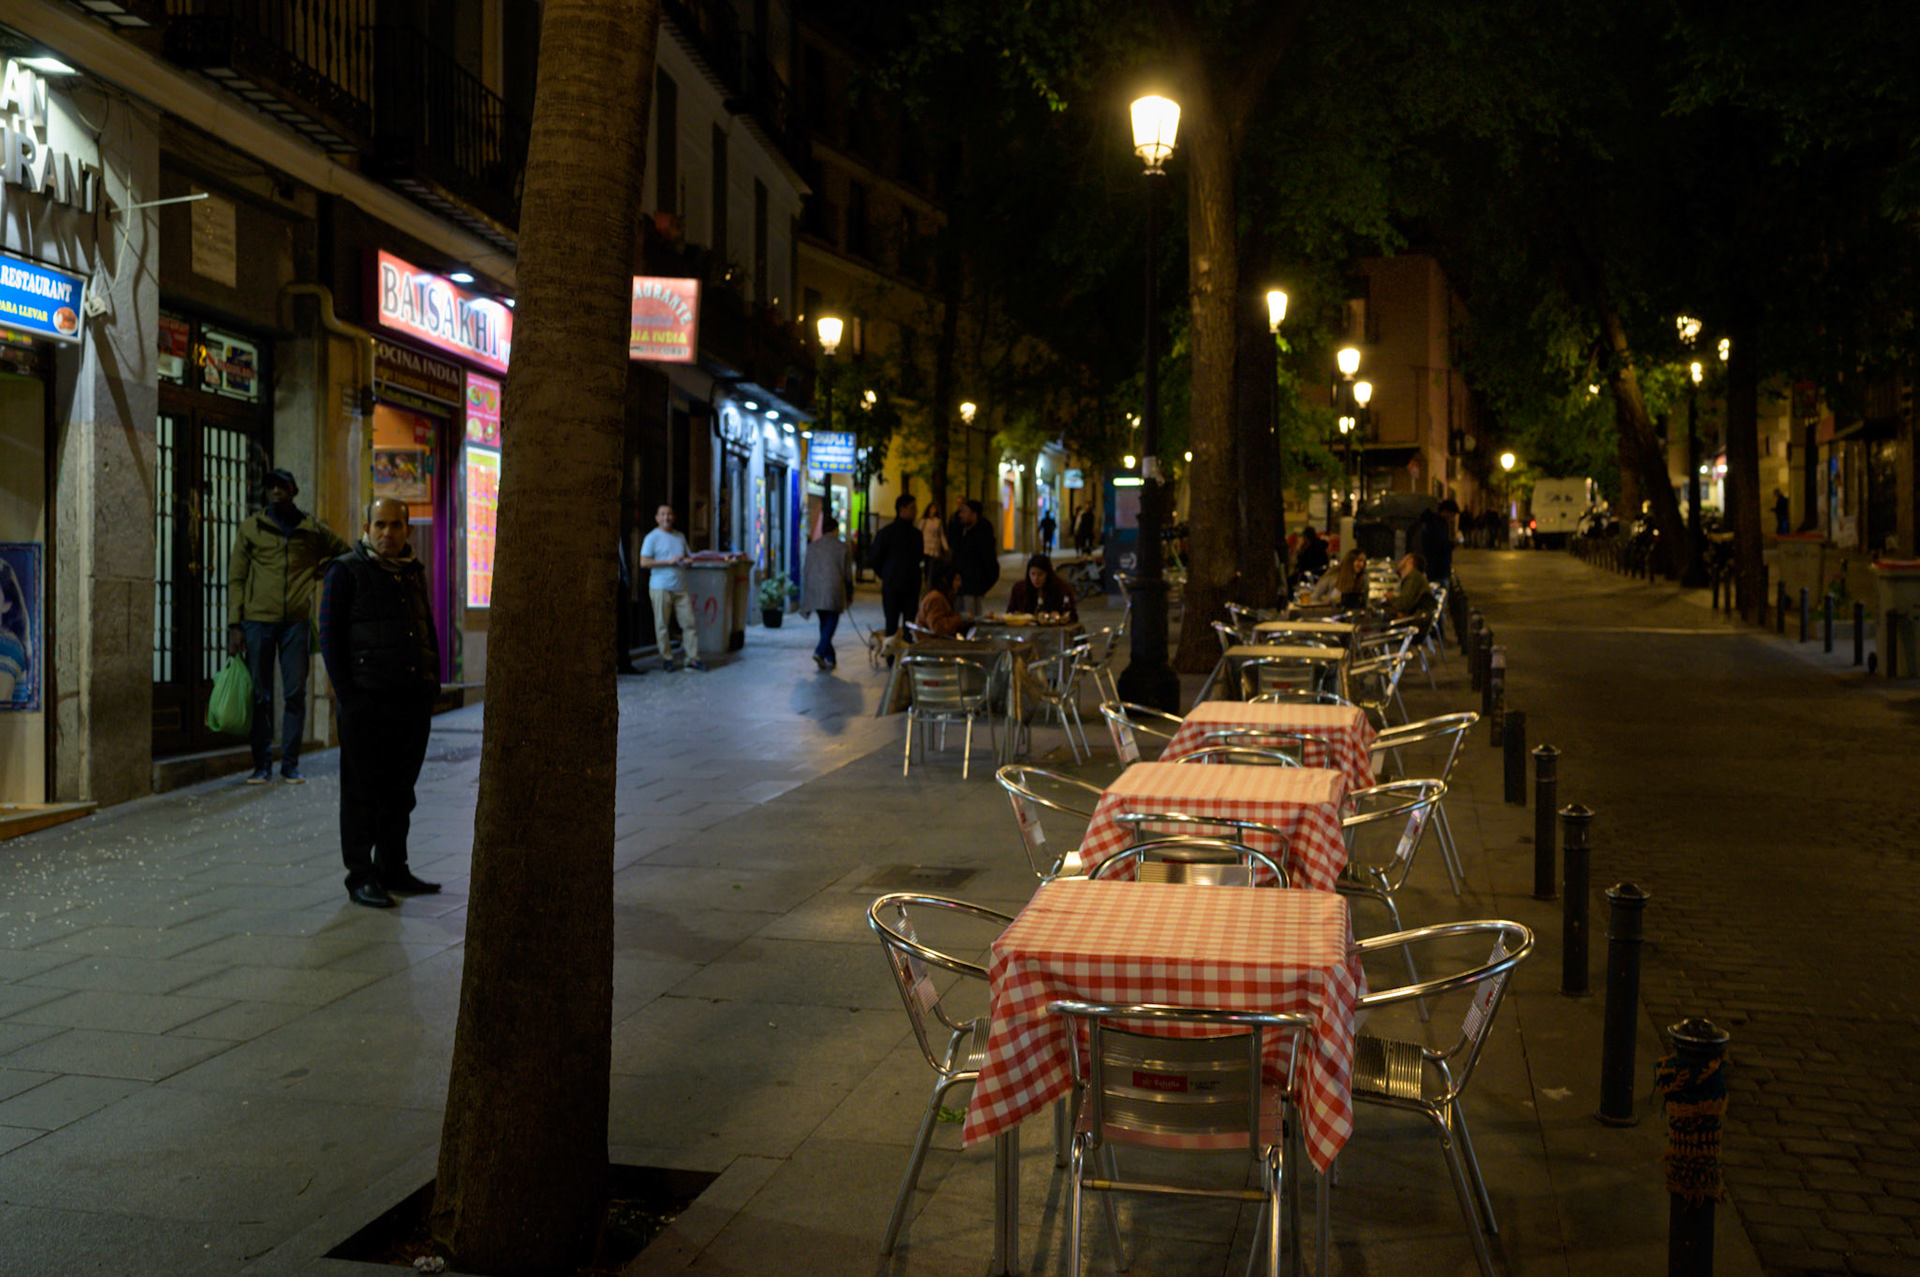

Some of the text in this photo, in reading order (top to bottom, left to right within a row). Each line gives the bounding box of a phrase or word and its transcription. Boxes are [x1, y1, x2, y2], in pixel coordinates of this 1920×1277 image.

[0, 264, 73, 303] RESTAURANT
[0, 299, 49, 323] ARA LLEVAR
[381, 263, 498, 357] BAISAKHI
[652, 331, 688, 345] INDIA
[423, 359, 459, 386] INDIA
